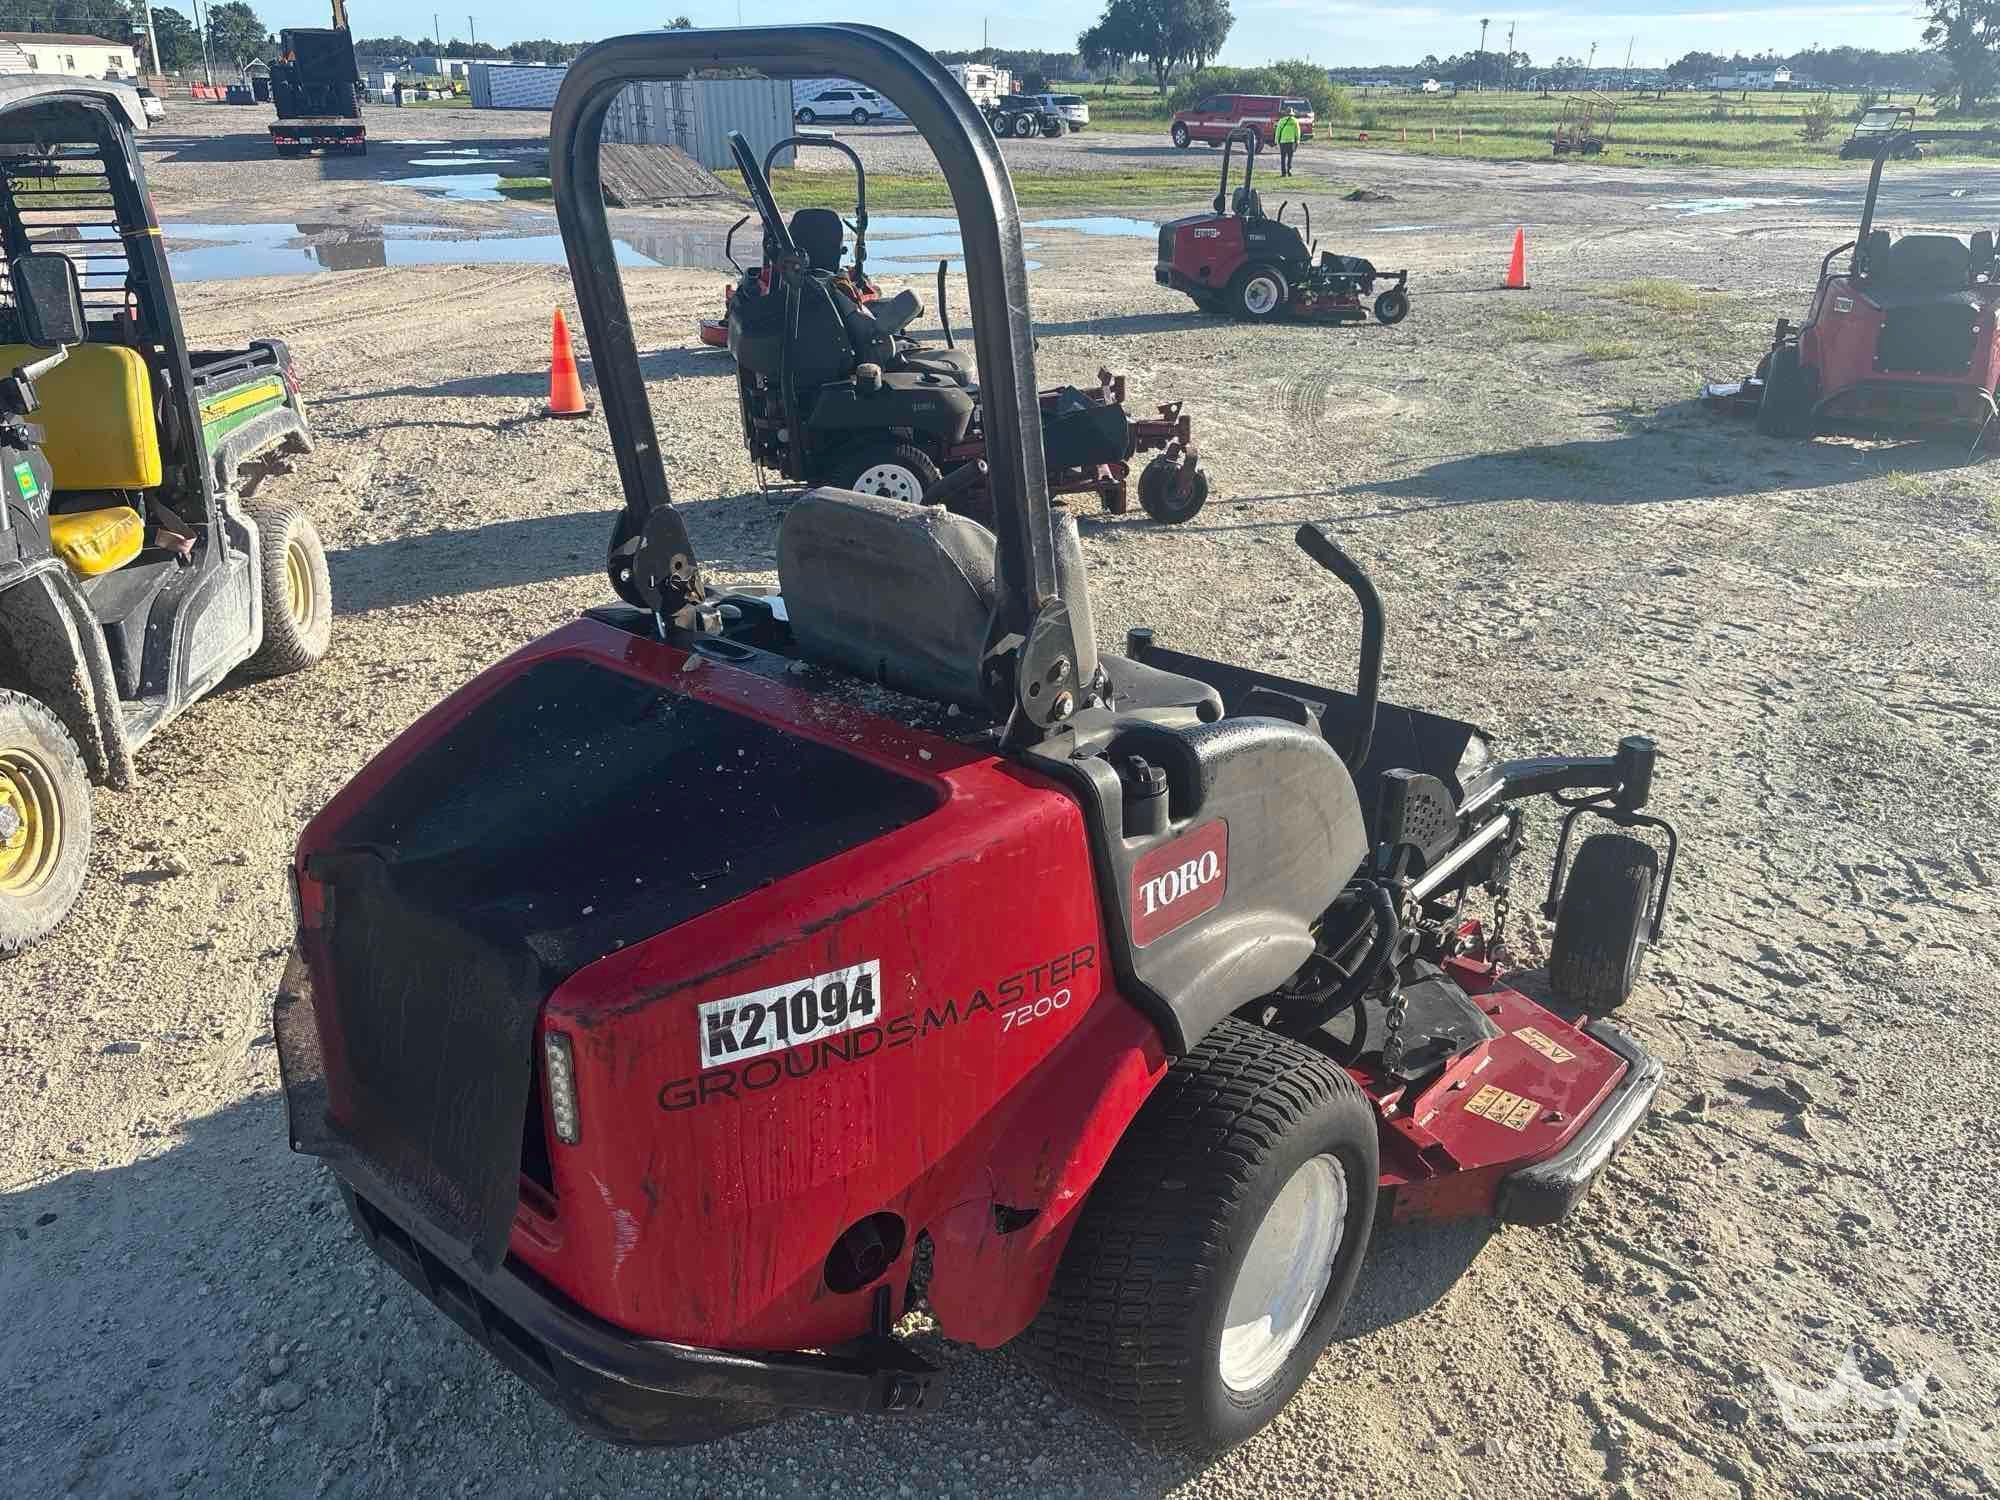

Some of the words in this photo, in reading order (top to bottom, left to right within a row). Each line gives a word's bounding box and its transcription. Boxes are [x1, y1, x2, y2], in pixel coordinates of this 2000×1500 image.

[1138, 850, 1221, 917] TORO
[657, 944, 1096, 1112] GROUNDSMASTER
[706, 973, 876, 1058] K21094
[1001, 988, 1071, 1033] 7200
